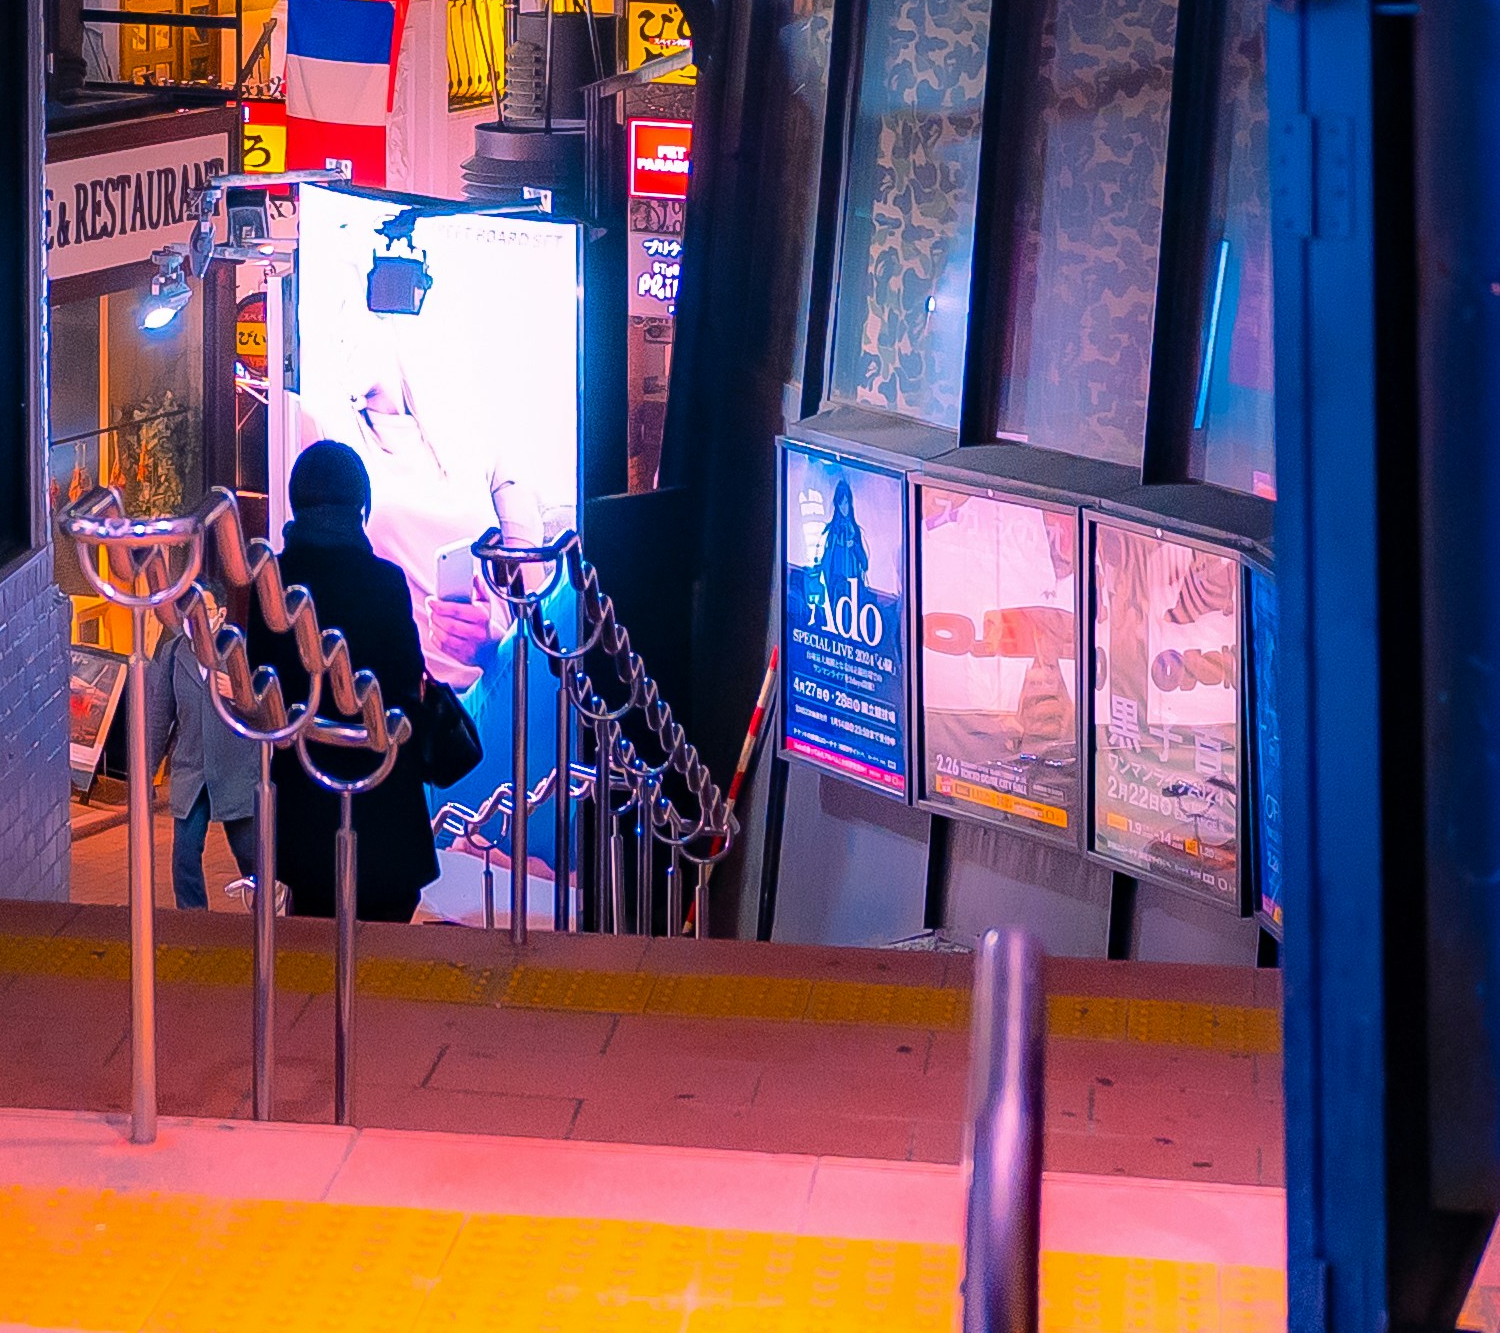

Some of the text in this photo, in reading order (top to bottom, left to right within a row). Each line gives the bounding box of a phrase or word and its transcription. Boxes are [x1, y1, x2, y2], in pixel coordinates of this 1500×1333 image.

[56, 201, 71, 248] &
[74, 157, 225, 245] RESTAURANT
[808, 569, 883, 647] Ado
[793, 628, 831, 652] SPECIAL
[832, 640, 854, 660] LIVE
[935, 753, 960, 776] 2.26
